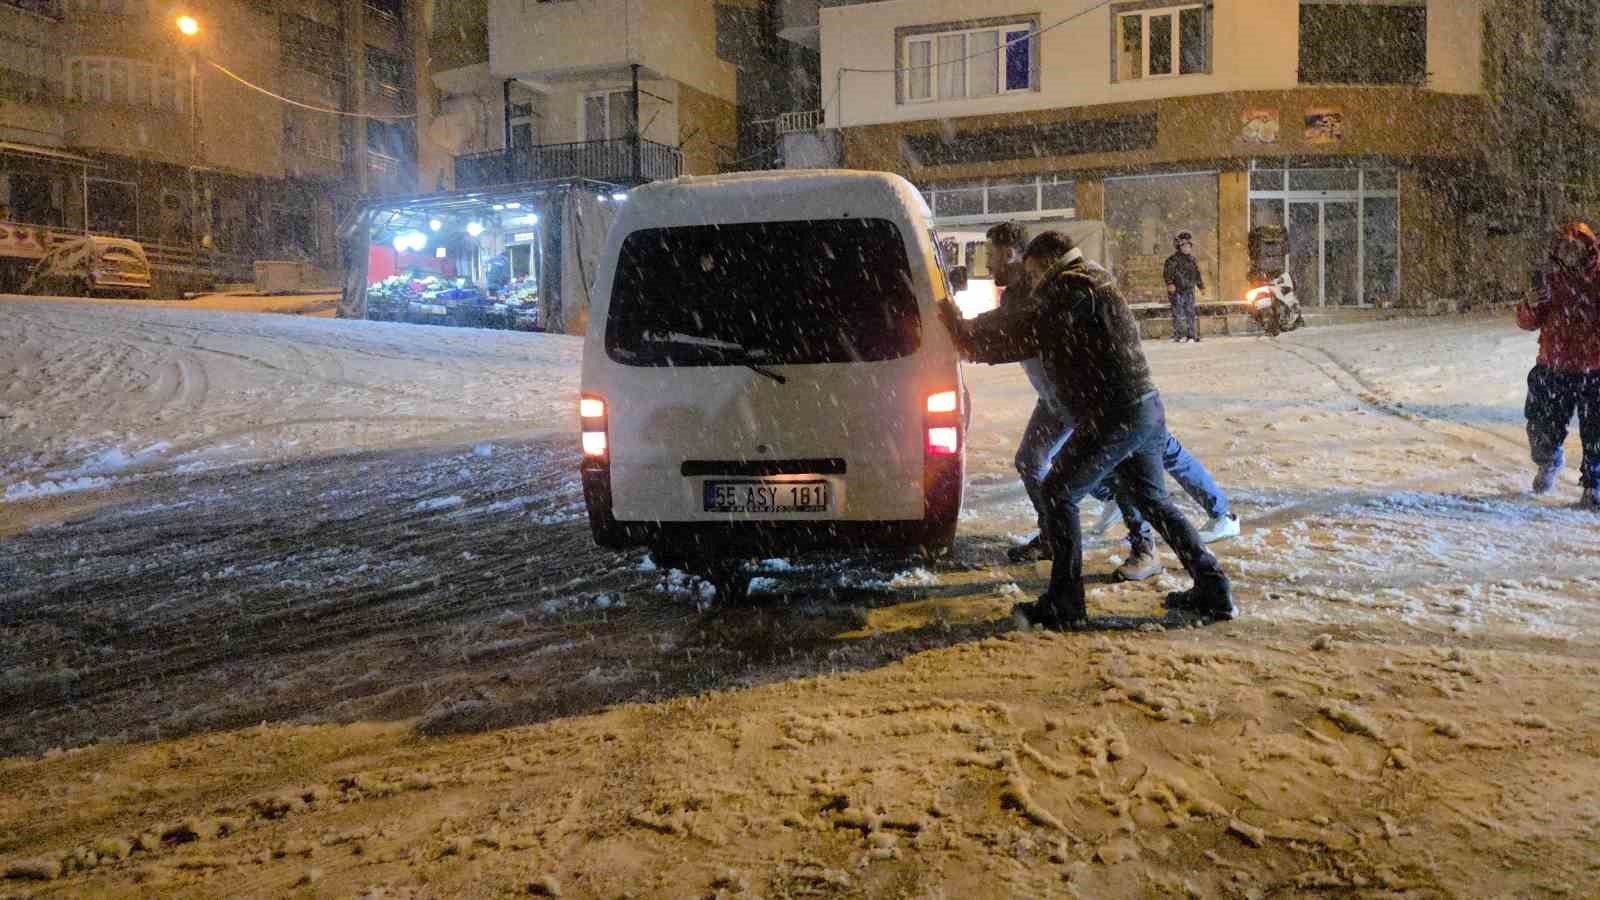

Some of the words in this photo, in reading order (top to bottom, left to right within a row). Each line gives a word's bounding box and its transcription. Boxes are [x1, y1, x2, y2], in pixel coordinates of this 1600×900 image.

[716, 487, 736, 505] 55
[747, 487, 777, 505] ASY
[791, 487, 820, 505] 181
